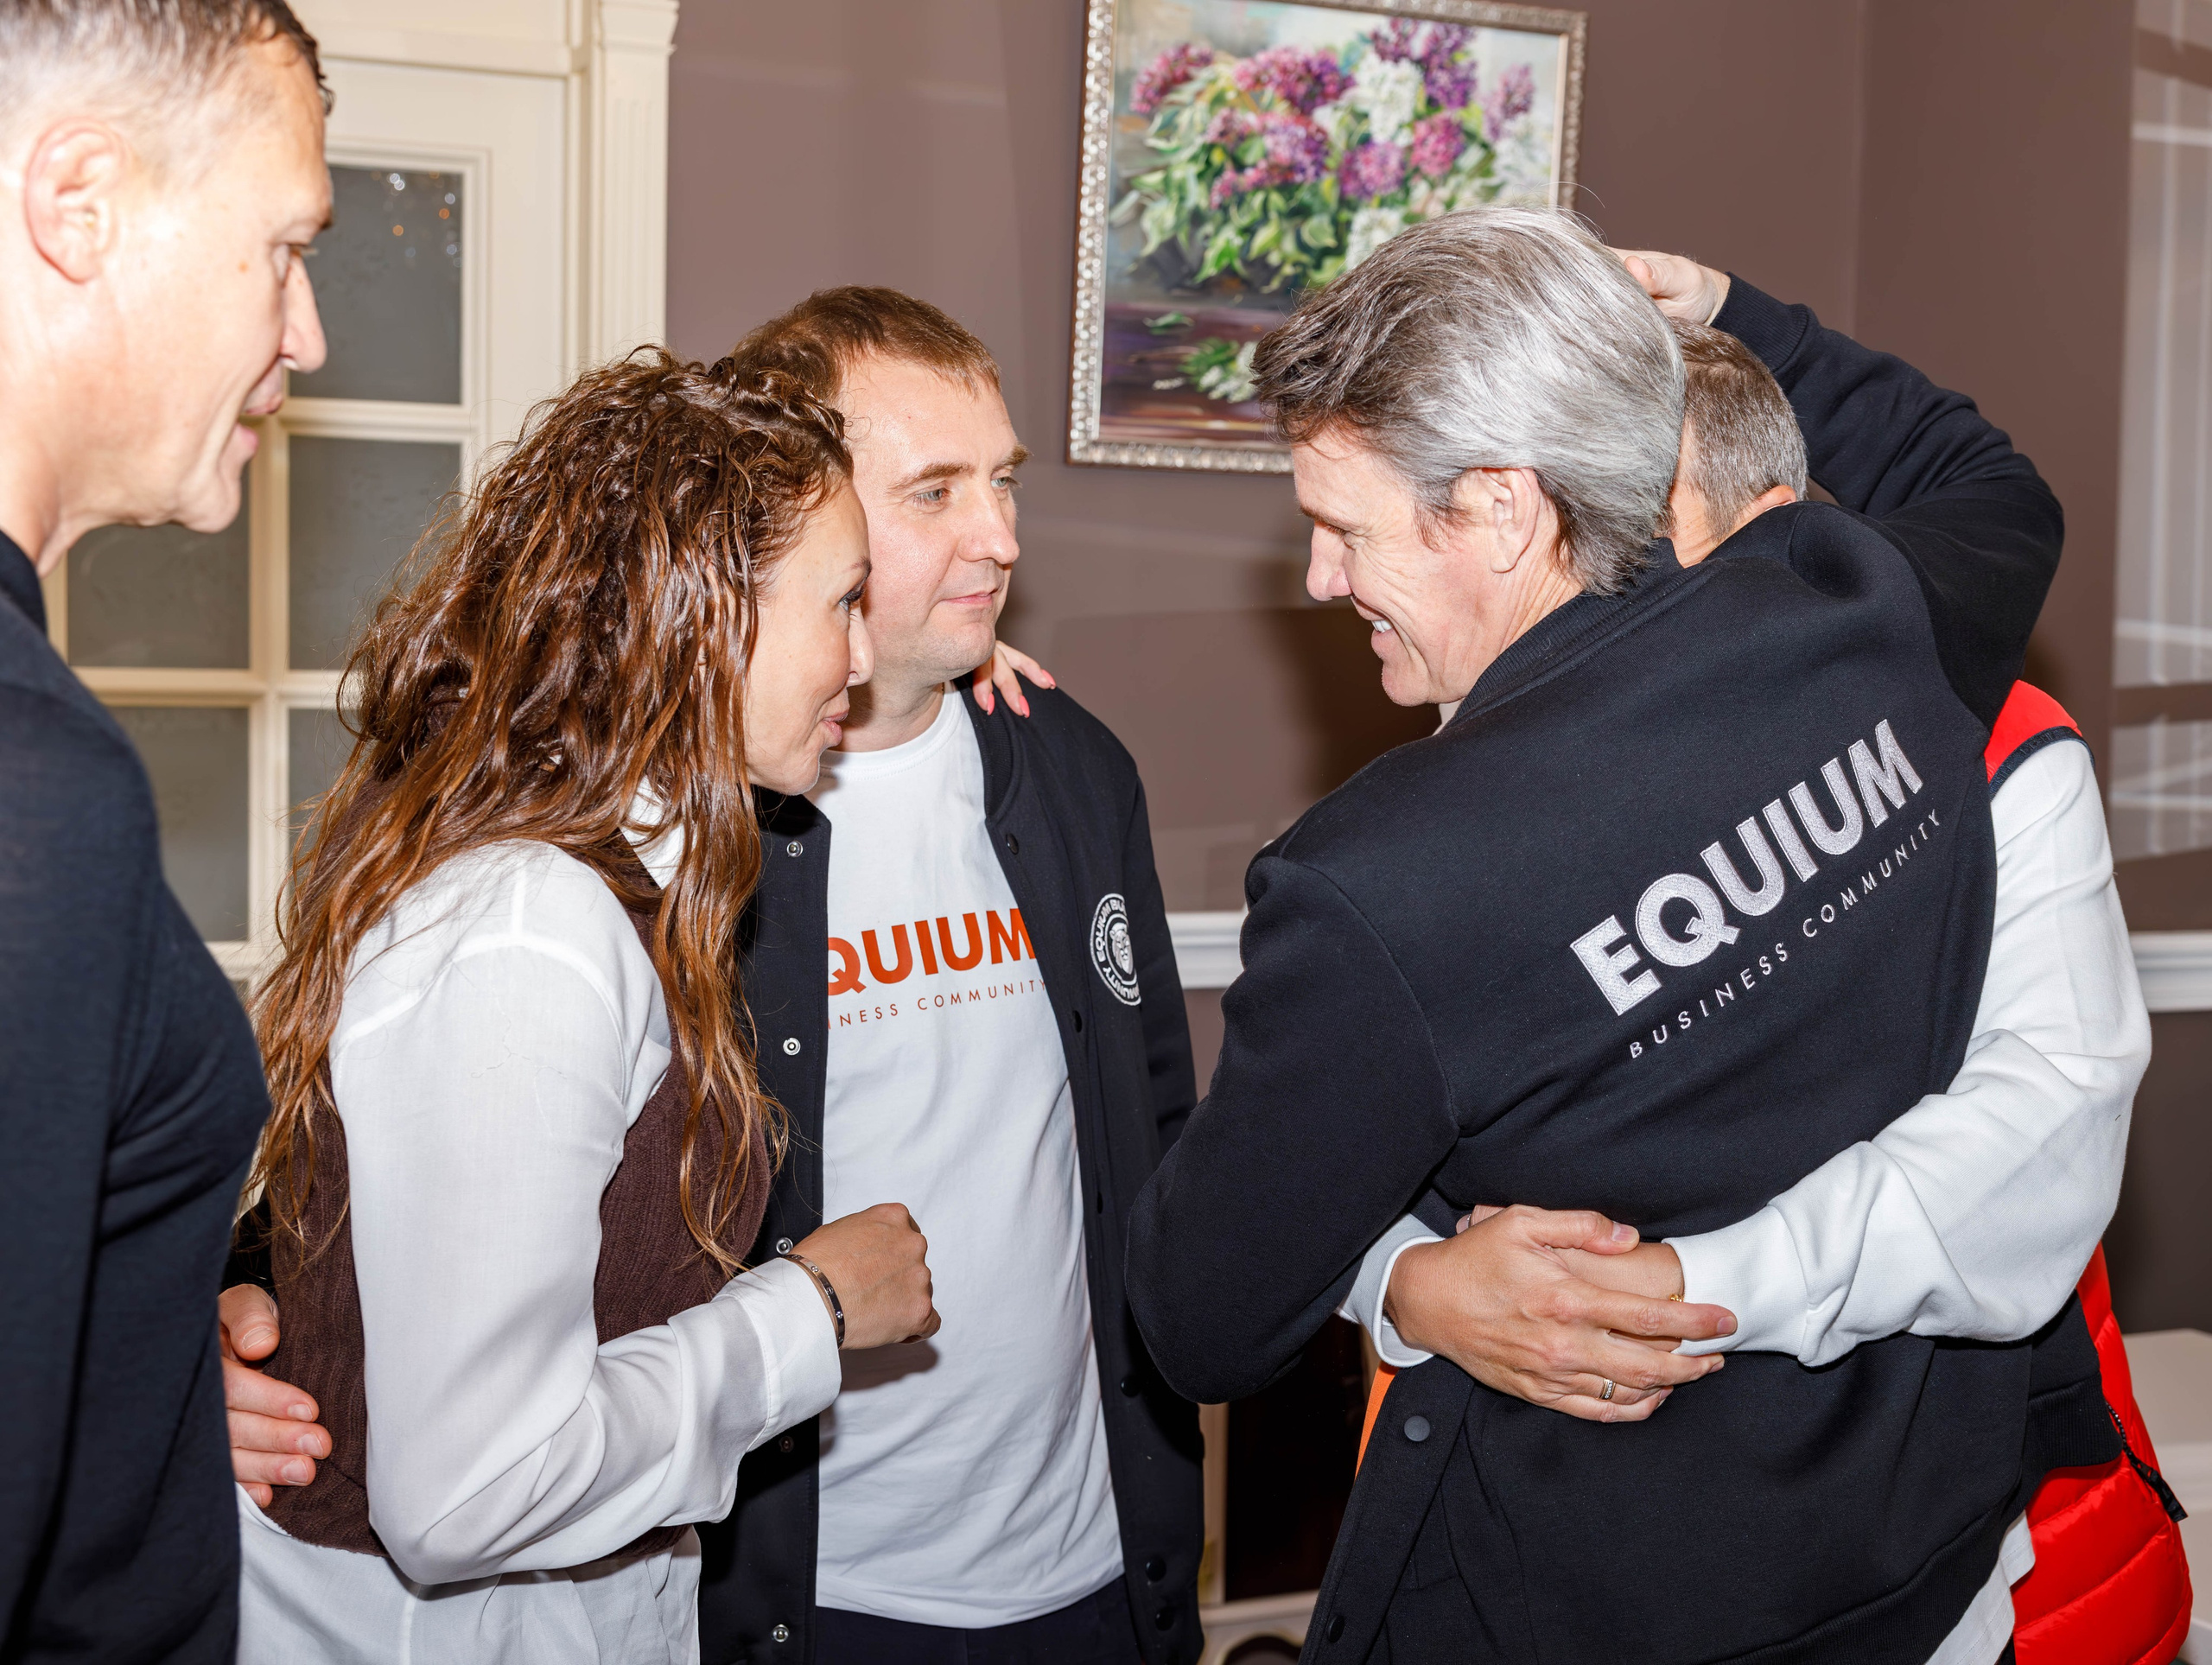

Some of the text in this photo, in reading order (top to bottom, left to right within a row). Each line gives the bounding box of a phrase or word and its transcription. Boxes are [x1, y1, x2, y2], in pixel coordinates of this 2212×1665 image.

[827, 907, 1037, 996] QUIUM
[1569, 718, 1923, 1016] EQUIUM
[1630, 809, 1941, 1058] BUSINESS COMMUNITY
[827, 978, 1046, 1030] INESS COMMUNITY
